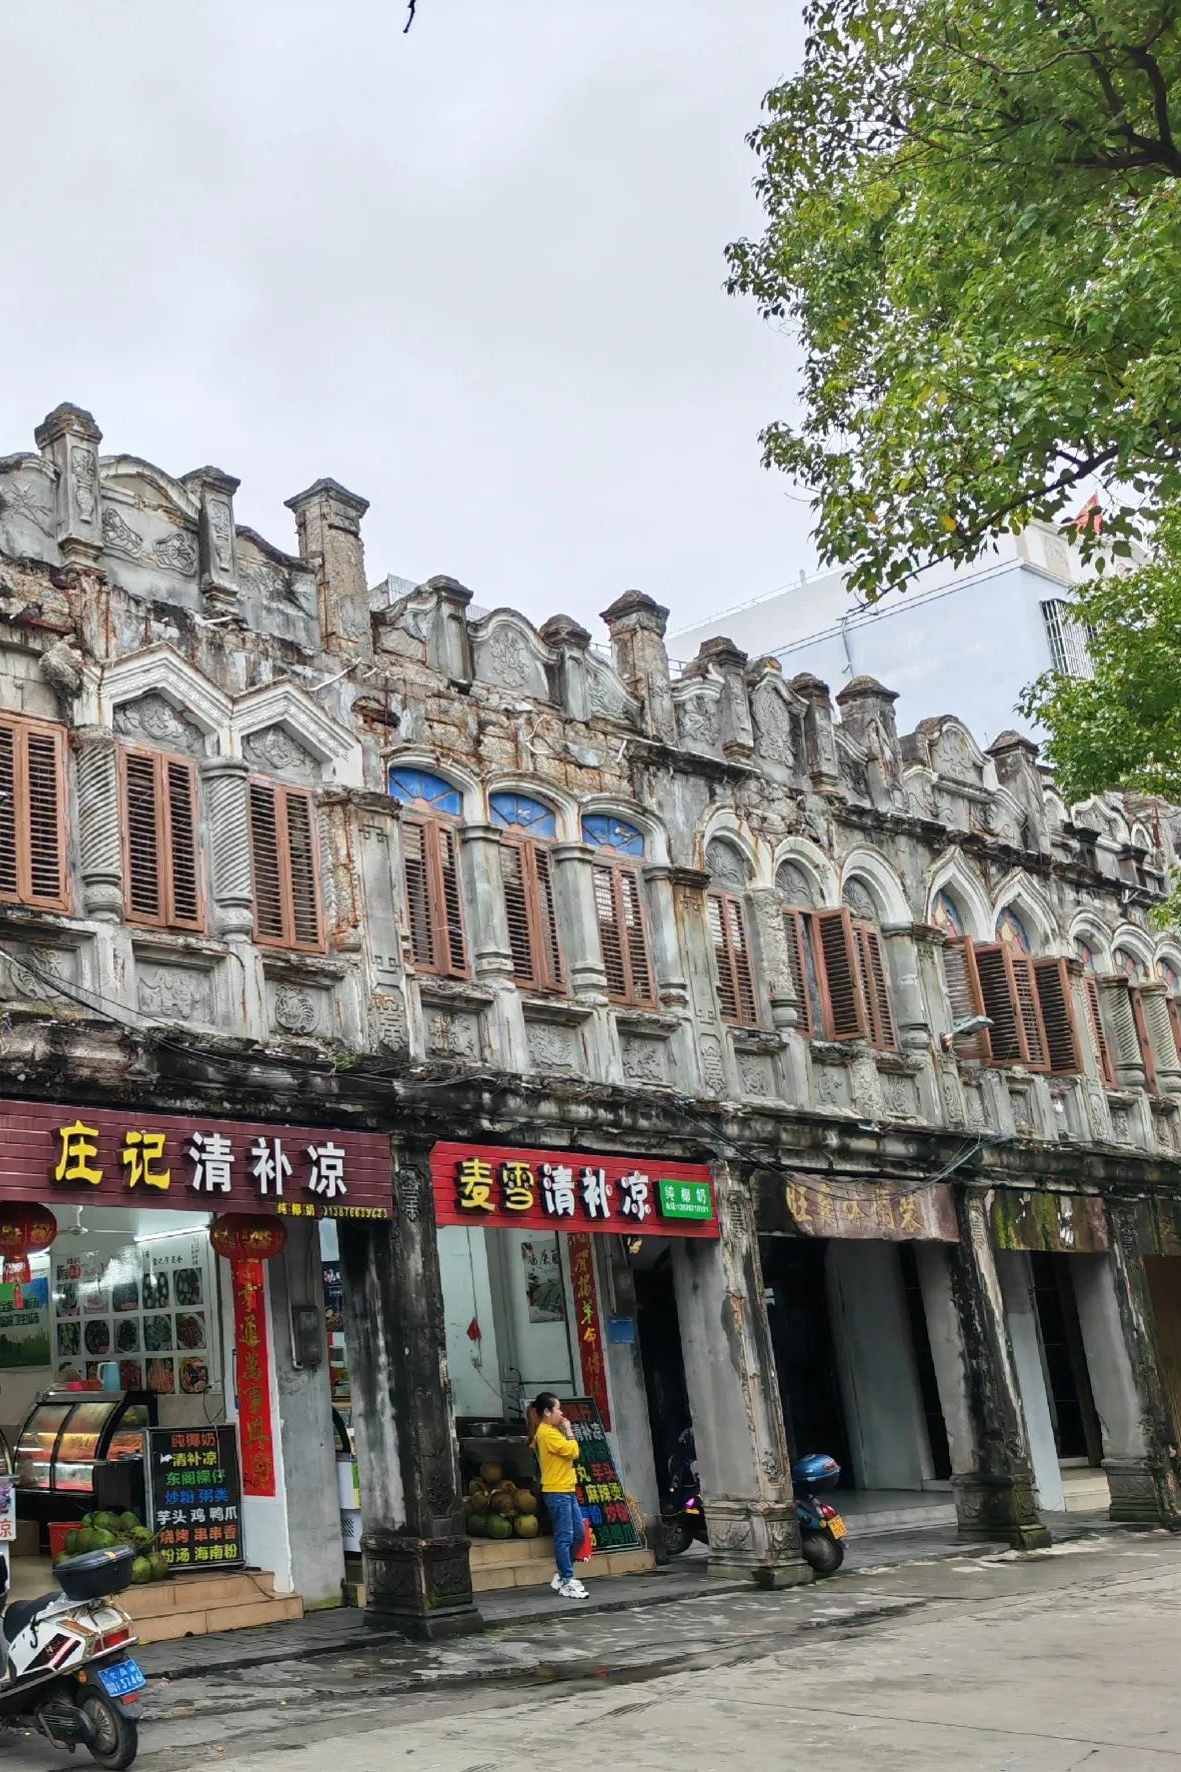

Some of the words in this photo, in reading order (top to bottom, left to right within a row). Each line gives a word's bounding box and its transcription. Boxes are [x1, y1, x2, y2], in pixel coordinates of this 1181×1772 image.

[54, 1119, 348, 1198] 庄记清补凉
[459, 1157, 652, 1221] 麦雪清补凉
[172, 1450, 218, 1467] 清补凉
[585, 1481, 624, 1504] 麻辣烫
[157, 1508, 187, 1525] 芋头
[190, 1507, 206, 1523] 鸡
[209, 1505, 238, 1522] 鸭爪
[160, 1529, 190, 1545] 烧烤
[193, 1525, 237, 1542] 串串香
[194, 1543, 238, 1561] 海南粉
